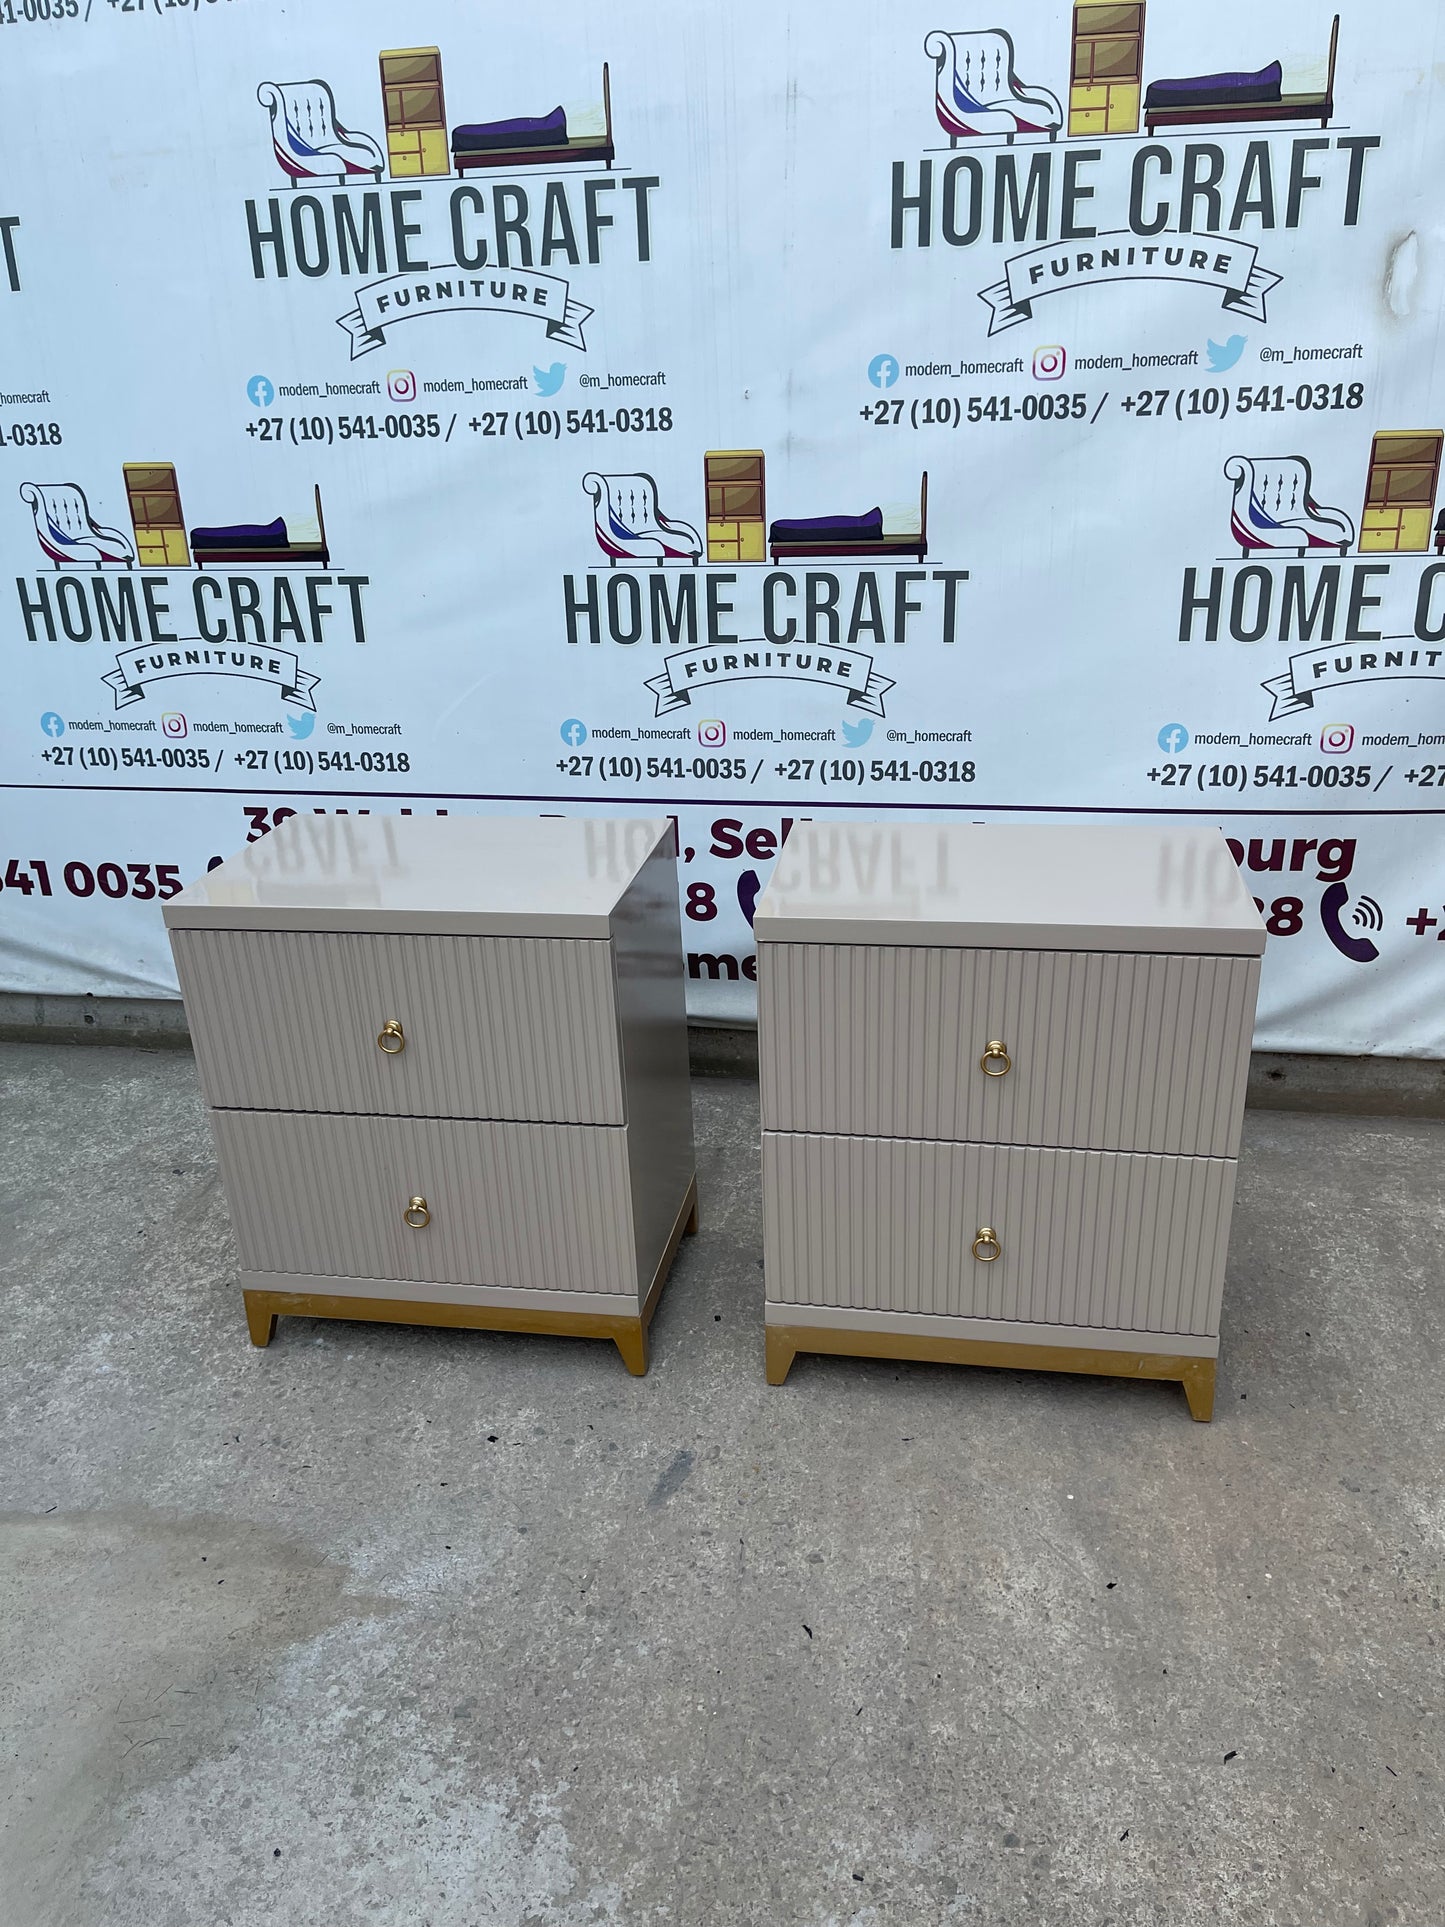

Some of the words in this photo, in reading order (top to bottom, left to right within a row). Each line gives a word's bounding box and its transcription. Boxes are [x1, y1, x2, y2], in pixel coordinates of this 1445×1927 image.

[891, 148, 1101, 249] HOME
[1128, 135, 1382, 236] CRAFT
[243, 190, 430, 282] HOME
[448, 175, 662, 272] CRAFT
[1028, 246, 1233, 285] FURNITURE
[376, 278, 551, 315] FURNITURE
[1260, 344, 1363, 364] @m_homecraft
[579, 371, 666, 389] @m_homecraft
[860, 400, 904, 425] +27
[911, 398, 961, 429] (10)
[967, 393, 1086, 422] 541-0035
[1121, 390, 1170, 416] +27
[1175, 388, 1229, 421] (10)
[1236, 382, 1364, 413] 541-0318
[246, 418, 283, 441] +27
[290, 417, 333, 446] (10)
[338, 414, 440, 439] 541-0035
[469, 412, 508, 436] +27
[515, 411, 561, 440] (10)
[567, 407, 673, 434] 541-0318
[16, 575, 179, 643] HOME
[192, 574, 371, 644] CRAFT
[562, 572, 738, 645] HOME
[763, 570, 969, 645] CRAFT
[1178, 564, 1391, 643] HOME
[133, 648, 283, 676] FURNITURE
[683, 650, 855, 680] FURNITURE
[327, 723, 402, 736] @m_homecraft
[887, 730, 972, 744] @m_homecraft
[41, 746, 73, 765] +27
[80, 747, 118, 771] (10)
[121, 748, 210, 768] 541-0035
[234, 750, 268, 769] +27
[274, 751, 313, 775] (10)
[318, 751, 410, 772] 541-0318
[556, 756, 593, 776] +27
[599, 757, 641, 782] (10)
[647, 757, 746, 779] 541-0035
[775, 759, 814, 780] +27
[820, 760, 864, 785] (10)
[870, 760, 975, 782] 541-0318
[1147, 764, 1192, 786] +27
[1198, 765, 1247, 792] (10)
[1253, 765, 1371, 787] 541-0035
